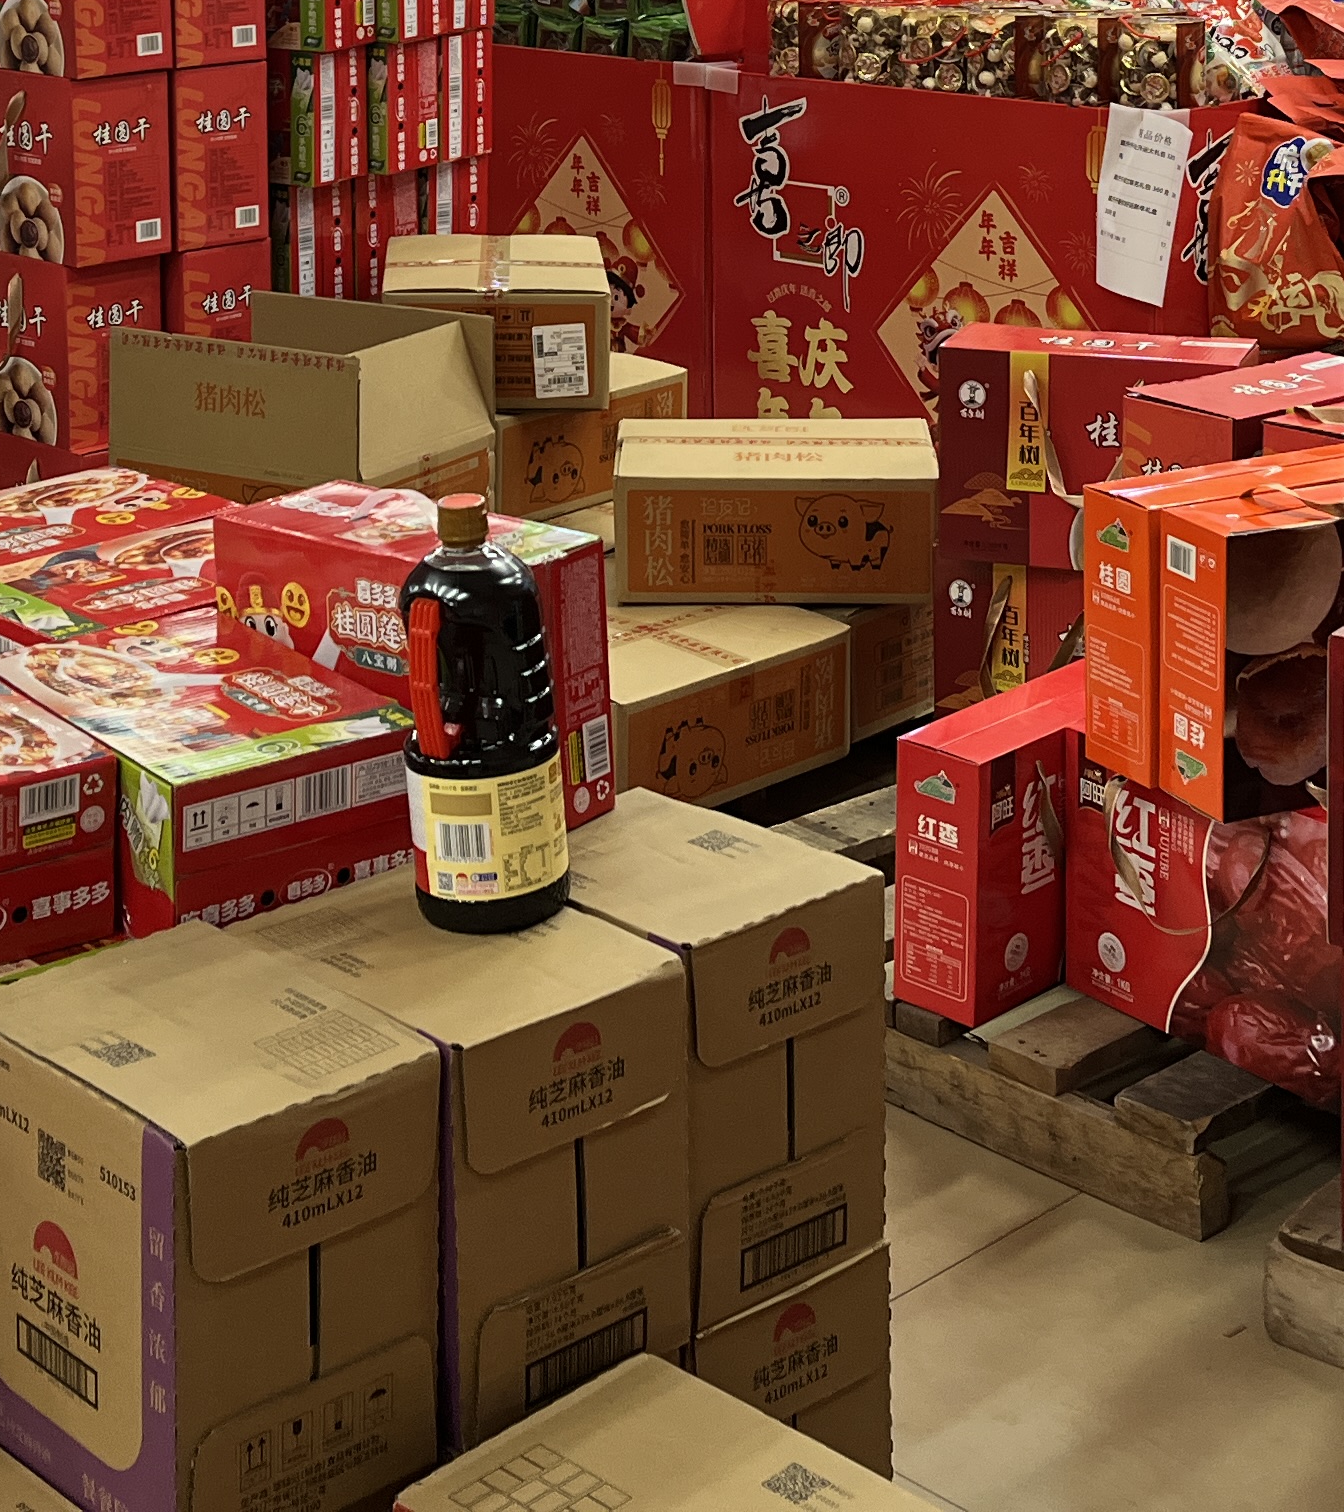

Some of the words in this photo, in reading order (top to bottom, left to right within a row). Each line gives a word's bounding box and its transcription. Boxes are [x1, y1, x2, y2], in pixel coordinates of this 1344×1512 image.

[92, 117, 151, 147] 桂圆干
[194, 106, 252, 134] 桂圆干
[86, 297, 145, 329] 桂圆干
[193, 381, 267, 419] 猪肉松
[1017, 400, 1042, 467] 百年树
[643, 495, 675, 587] 猪肉松
[702, 523, 735, 535] PORK
[737, 522, 773, 535] FLOSS
[355, 579, 399, 609] 喜多多
[1097, 560, 1133, 593] 桂圆
[332, 604, 410, 651] 桂圆莲
[999, 602, 1022, 669] 百年树
[359, 652, 399, 673] 八宝粥
[916, 813, 959, 850] 红枣
[31, 880, 111, 921] 喜事多多
[747, 961, 833, 1013] 纯芝麻香油
[759, 991, 822, 1027] 410mLX12
[528, 1055, 626, 1113] 纯芝麻香油
[541, 1088, 613, 1128] 410mLX12
[98, 1165, 137, 1203] 510153
[267, 1149, 378, 1214] 纯芝麻香油
[281, 1184, 364, 1229] 410mLX12
[10, 1261, 102, 1354] 纯芝麻香油
[753, 1334, 839, 1387] 纯芝麻香油
[764, 1363, 829, 1405] 410mLX12
